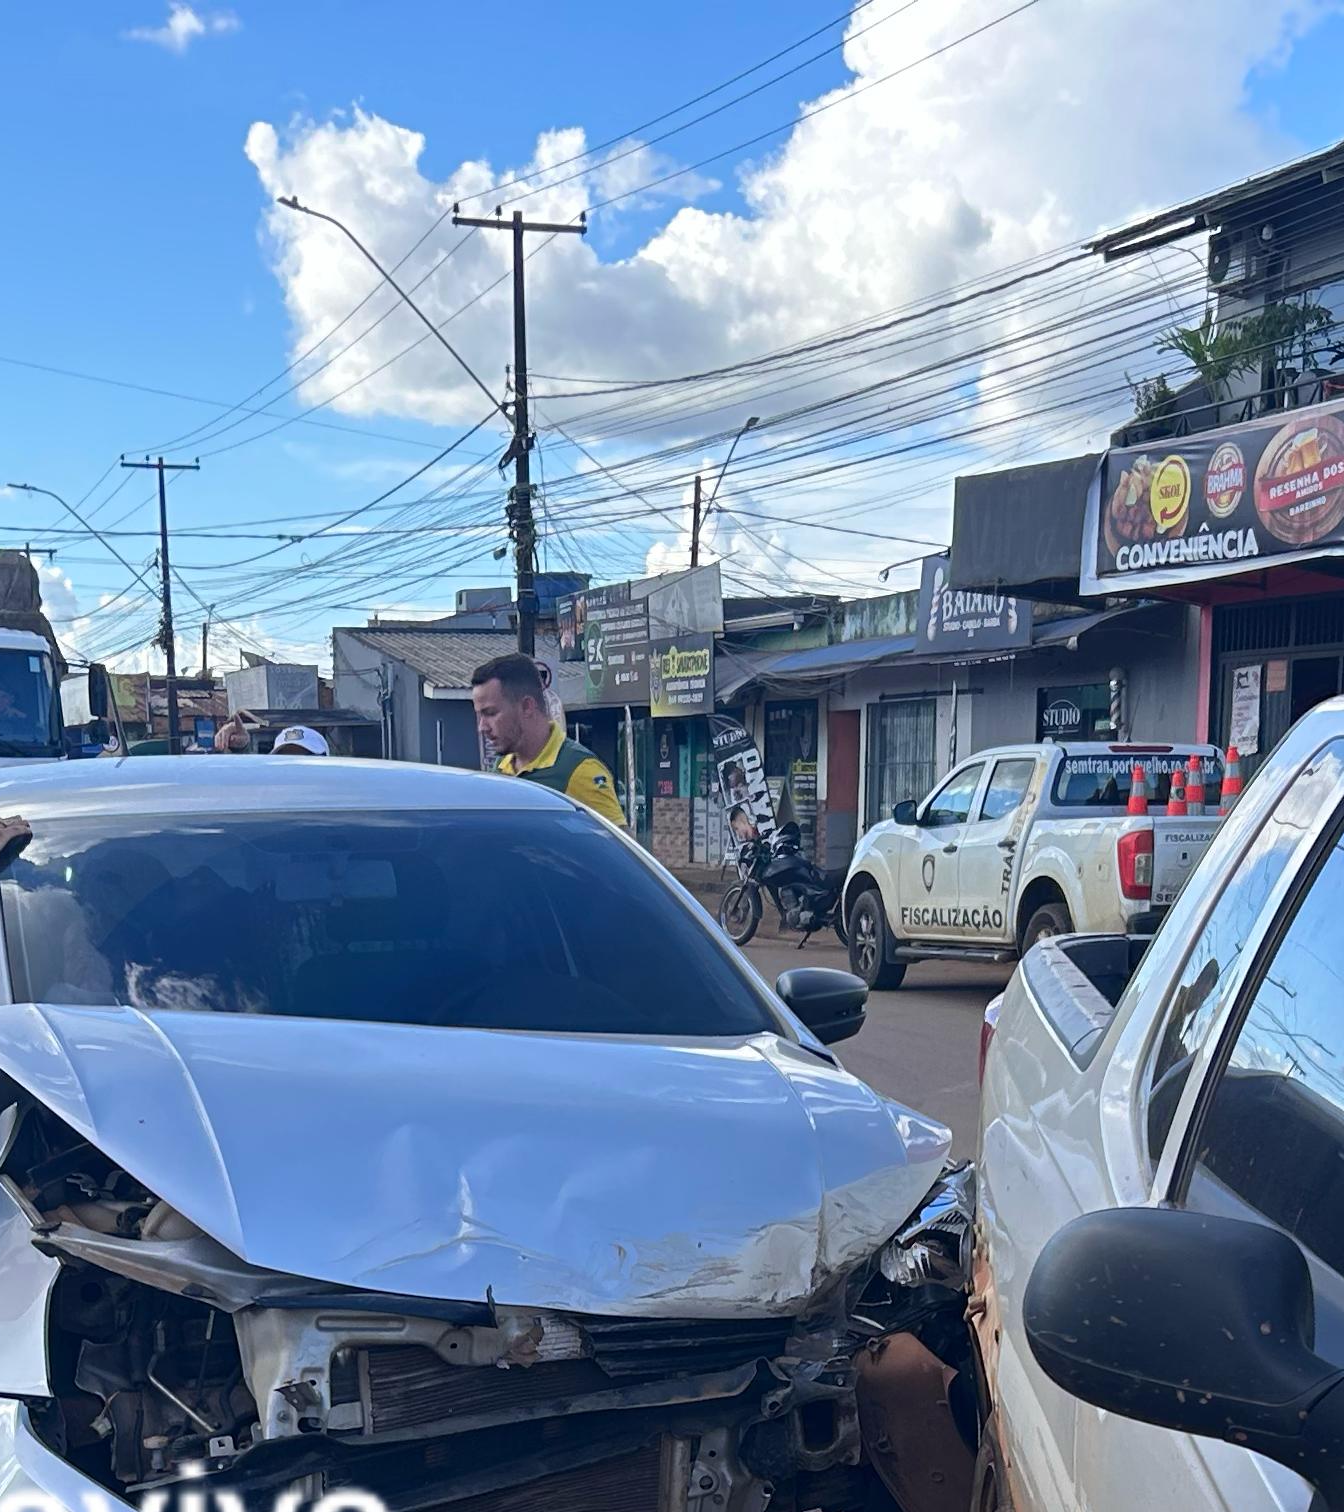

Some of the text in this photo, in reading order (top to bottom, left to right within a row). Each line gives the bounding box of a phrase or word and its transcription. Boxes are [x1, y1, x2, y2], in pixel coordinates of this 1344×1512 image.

[1159, 484, 1181, 499] SKOL
[1207, 467, 1244, 494] BRAHMA
[1269, 461, 1344, 500] RESENHA DOS
[1116, 522, 1259, 571] CONVENIÊNCIA
[1042, 707, 1081, 726] STUDIO
[1165, 833, 1214, 842] FISCALIZA
[901, 905, 1003, 931] FISCALIZAÇÃO
